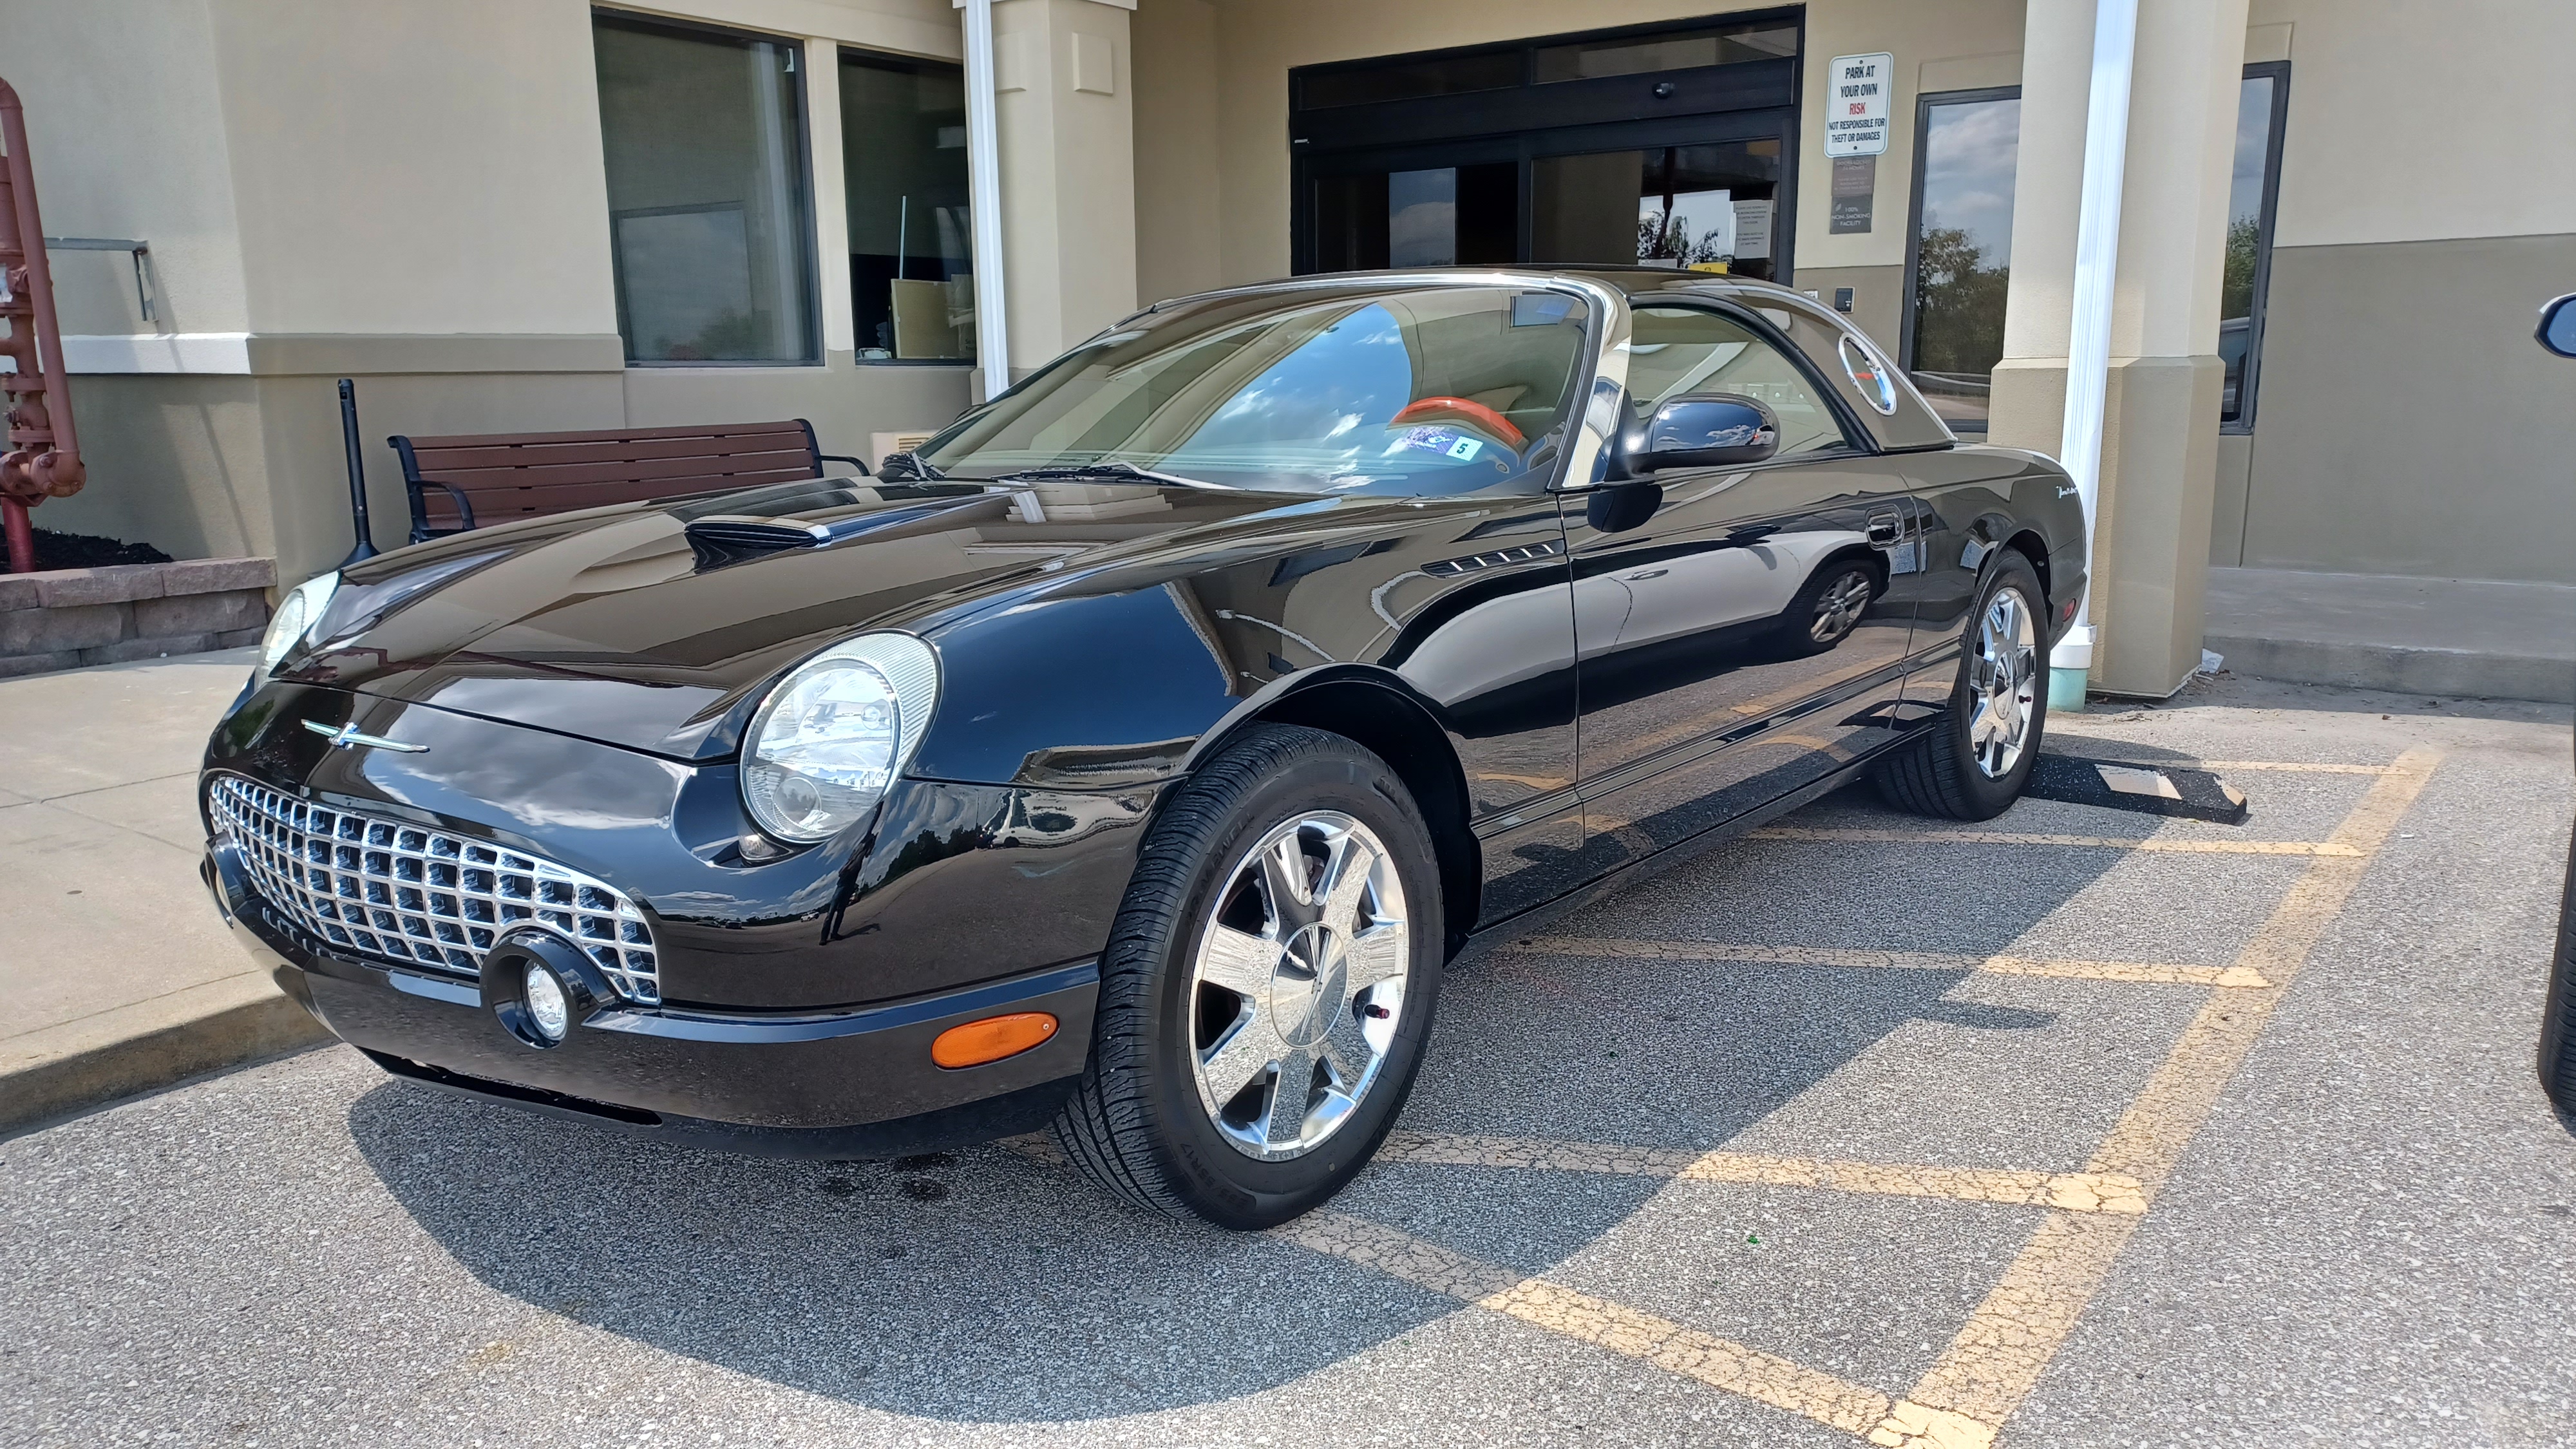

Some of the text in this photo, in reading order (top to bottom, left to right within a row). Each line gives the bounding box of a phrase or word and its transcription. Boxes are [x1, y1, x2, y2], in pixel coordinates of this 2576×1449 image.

[1845, 65, 1875, 79] PARK AT
[1841, 83, 1877, 98] YOUR OWN
[1849, 102, 1866, 115] RISK
[1829, 118, 1885, 130] NOT RESPONSIBLE FOR
[1832, 131, 1880, 143] THEFT OR DAMAGES
[1457, 443, 1468, 454] 5
